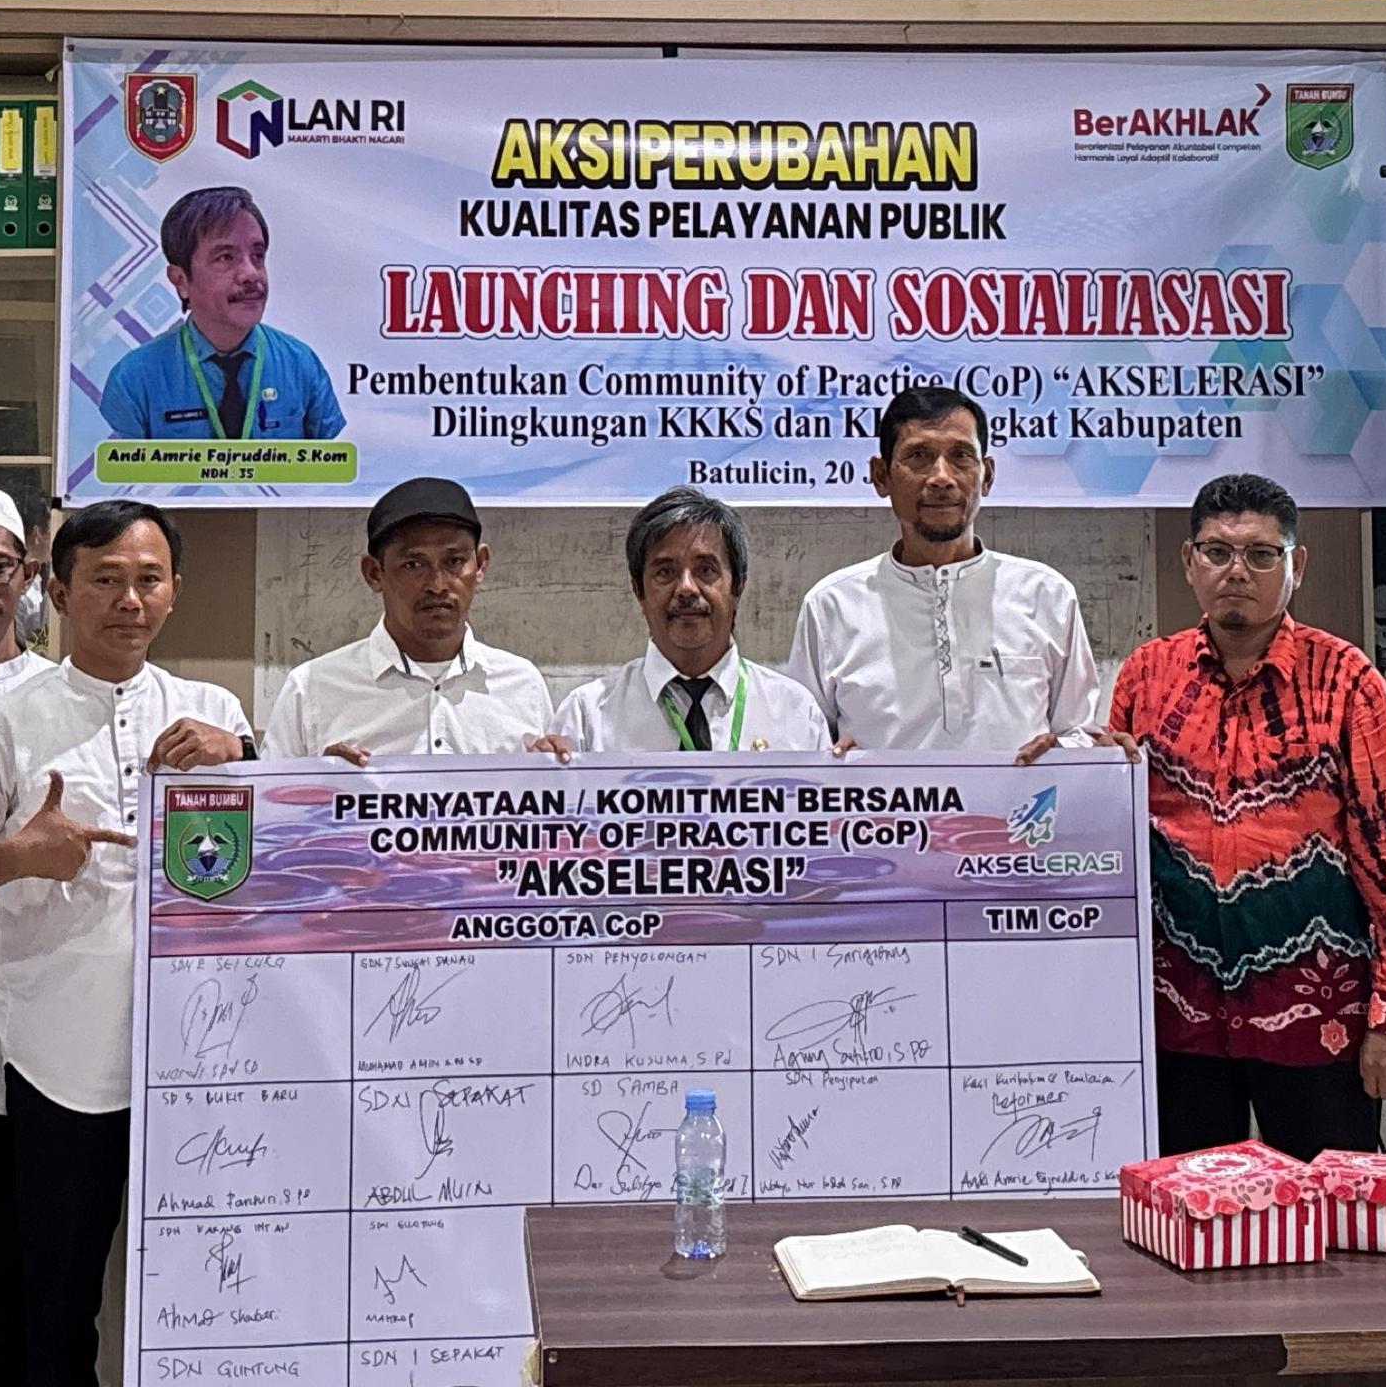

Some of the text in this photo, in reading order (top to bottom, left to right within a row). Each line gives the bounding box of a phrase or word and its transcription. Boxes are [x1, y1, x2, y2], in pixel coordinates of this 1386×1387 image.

[492, 119, 977, 190] AKSI PERUBAHAN
[459, 200, 1008, 240] KUALITAS PELAYANAN PUBLIK
[174, 791, 245, 808] TANAH BUMBU
[334, 789, 567, 820] PERNYATAAN
[596, 787, 786, 816] KOMITMEN
[797, 786, 965, 813] BERSAMA
[369, 820, 930, 854] COMMUNITY OF PRACTICE (CoP)
[451, 913, 661, 940] ANGGOTA CoP
[985, 907, 1102, 931] TIM CoP
[357, 1348, 399, 1367] SDN
[430, 1345, 505, 1365] SEPAKAT
